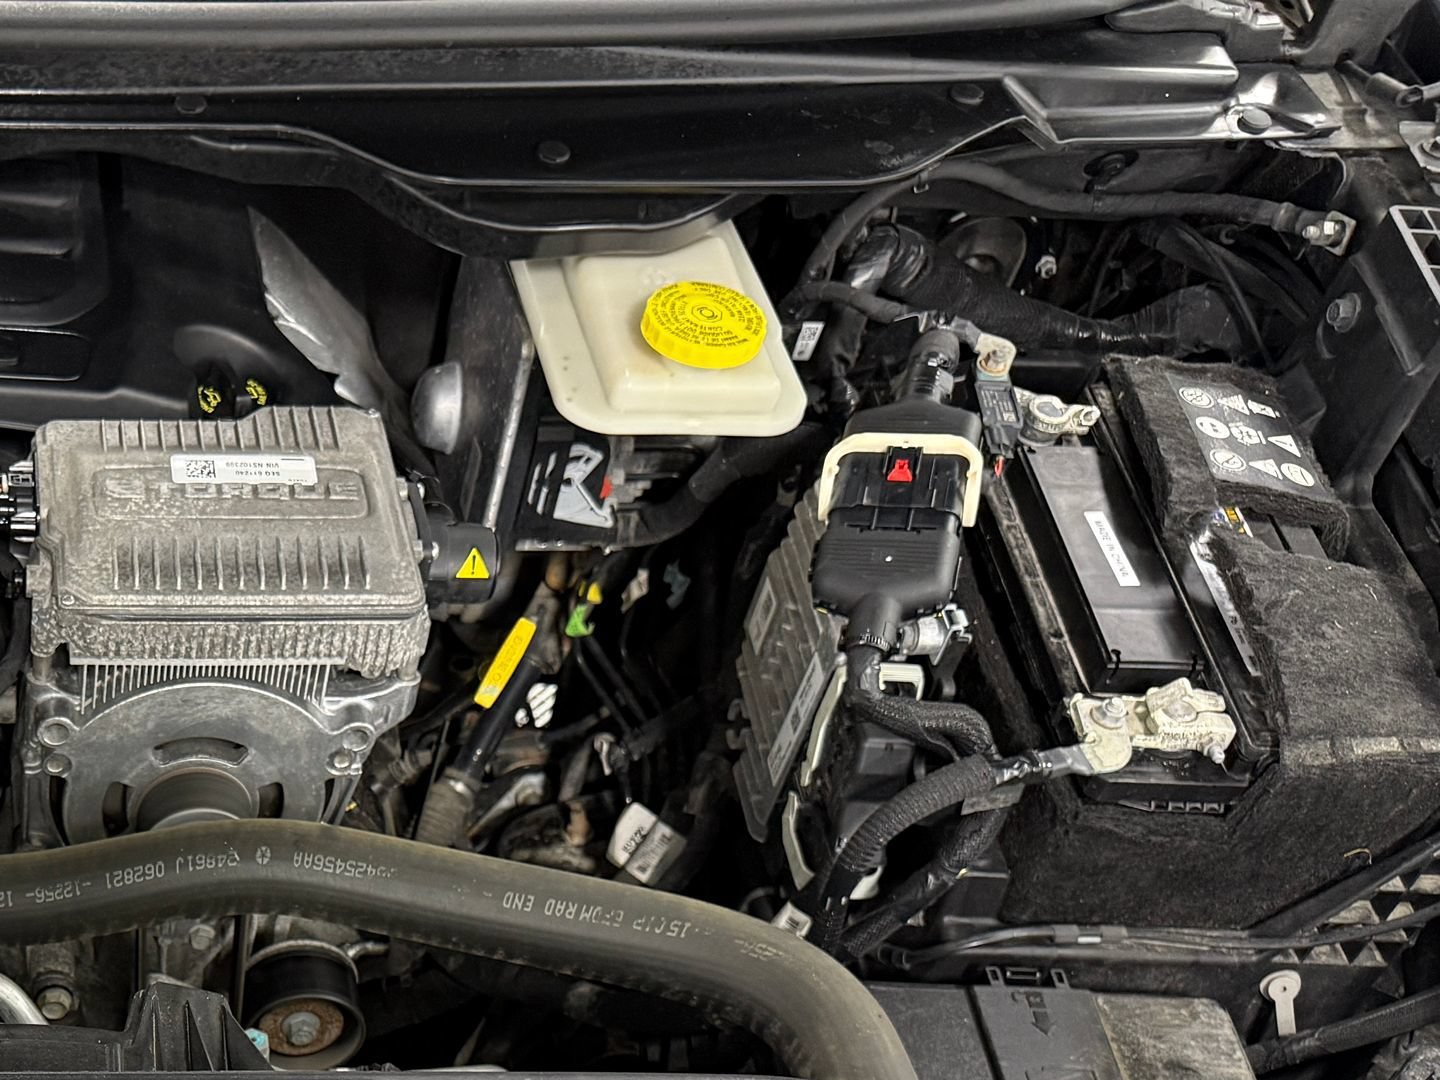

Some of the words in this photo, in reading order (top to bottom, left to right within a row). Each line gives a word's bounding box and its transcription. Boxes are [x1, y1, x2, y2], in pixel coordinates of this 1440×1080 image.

[105, 862, 165, 890] 062821
[293, 852, 397, 878] 425456AA
[502, 891, 534, 912] END
[544, 898, 578, 920] RAD
